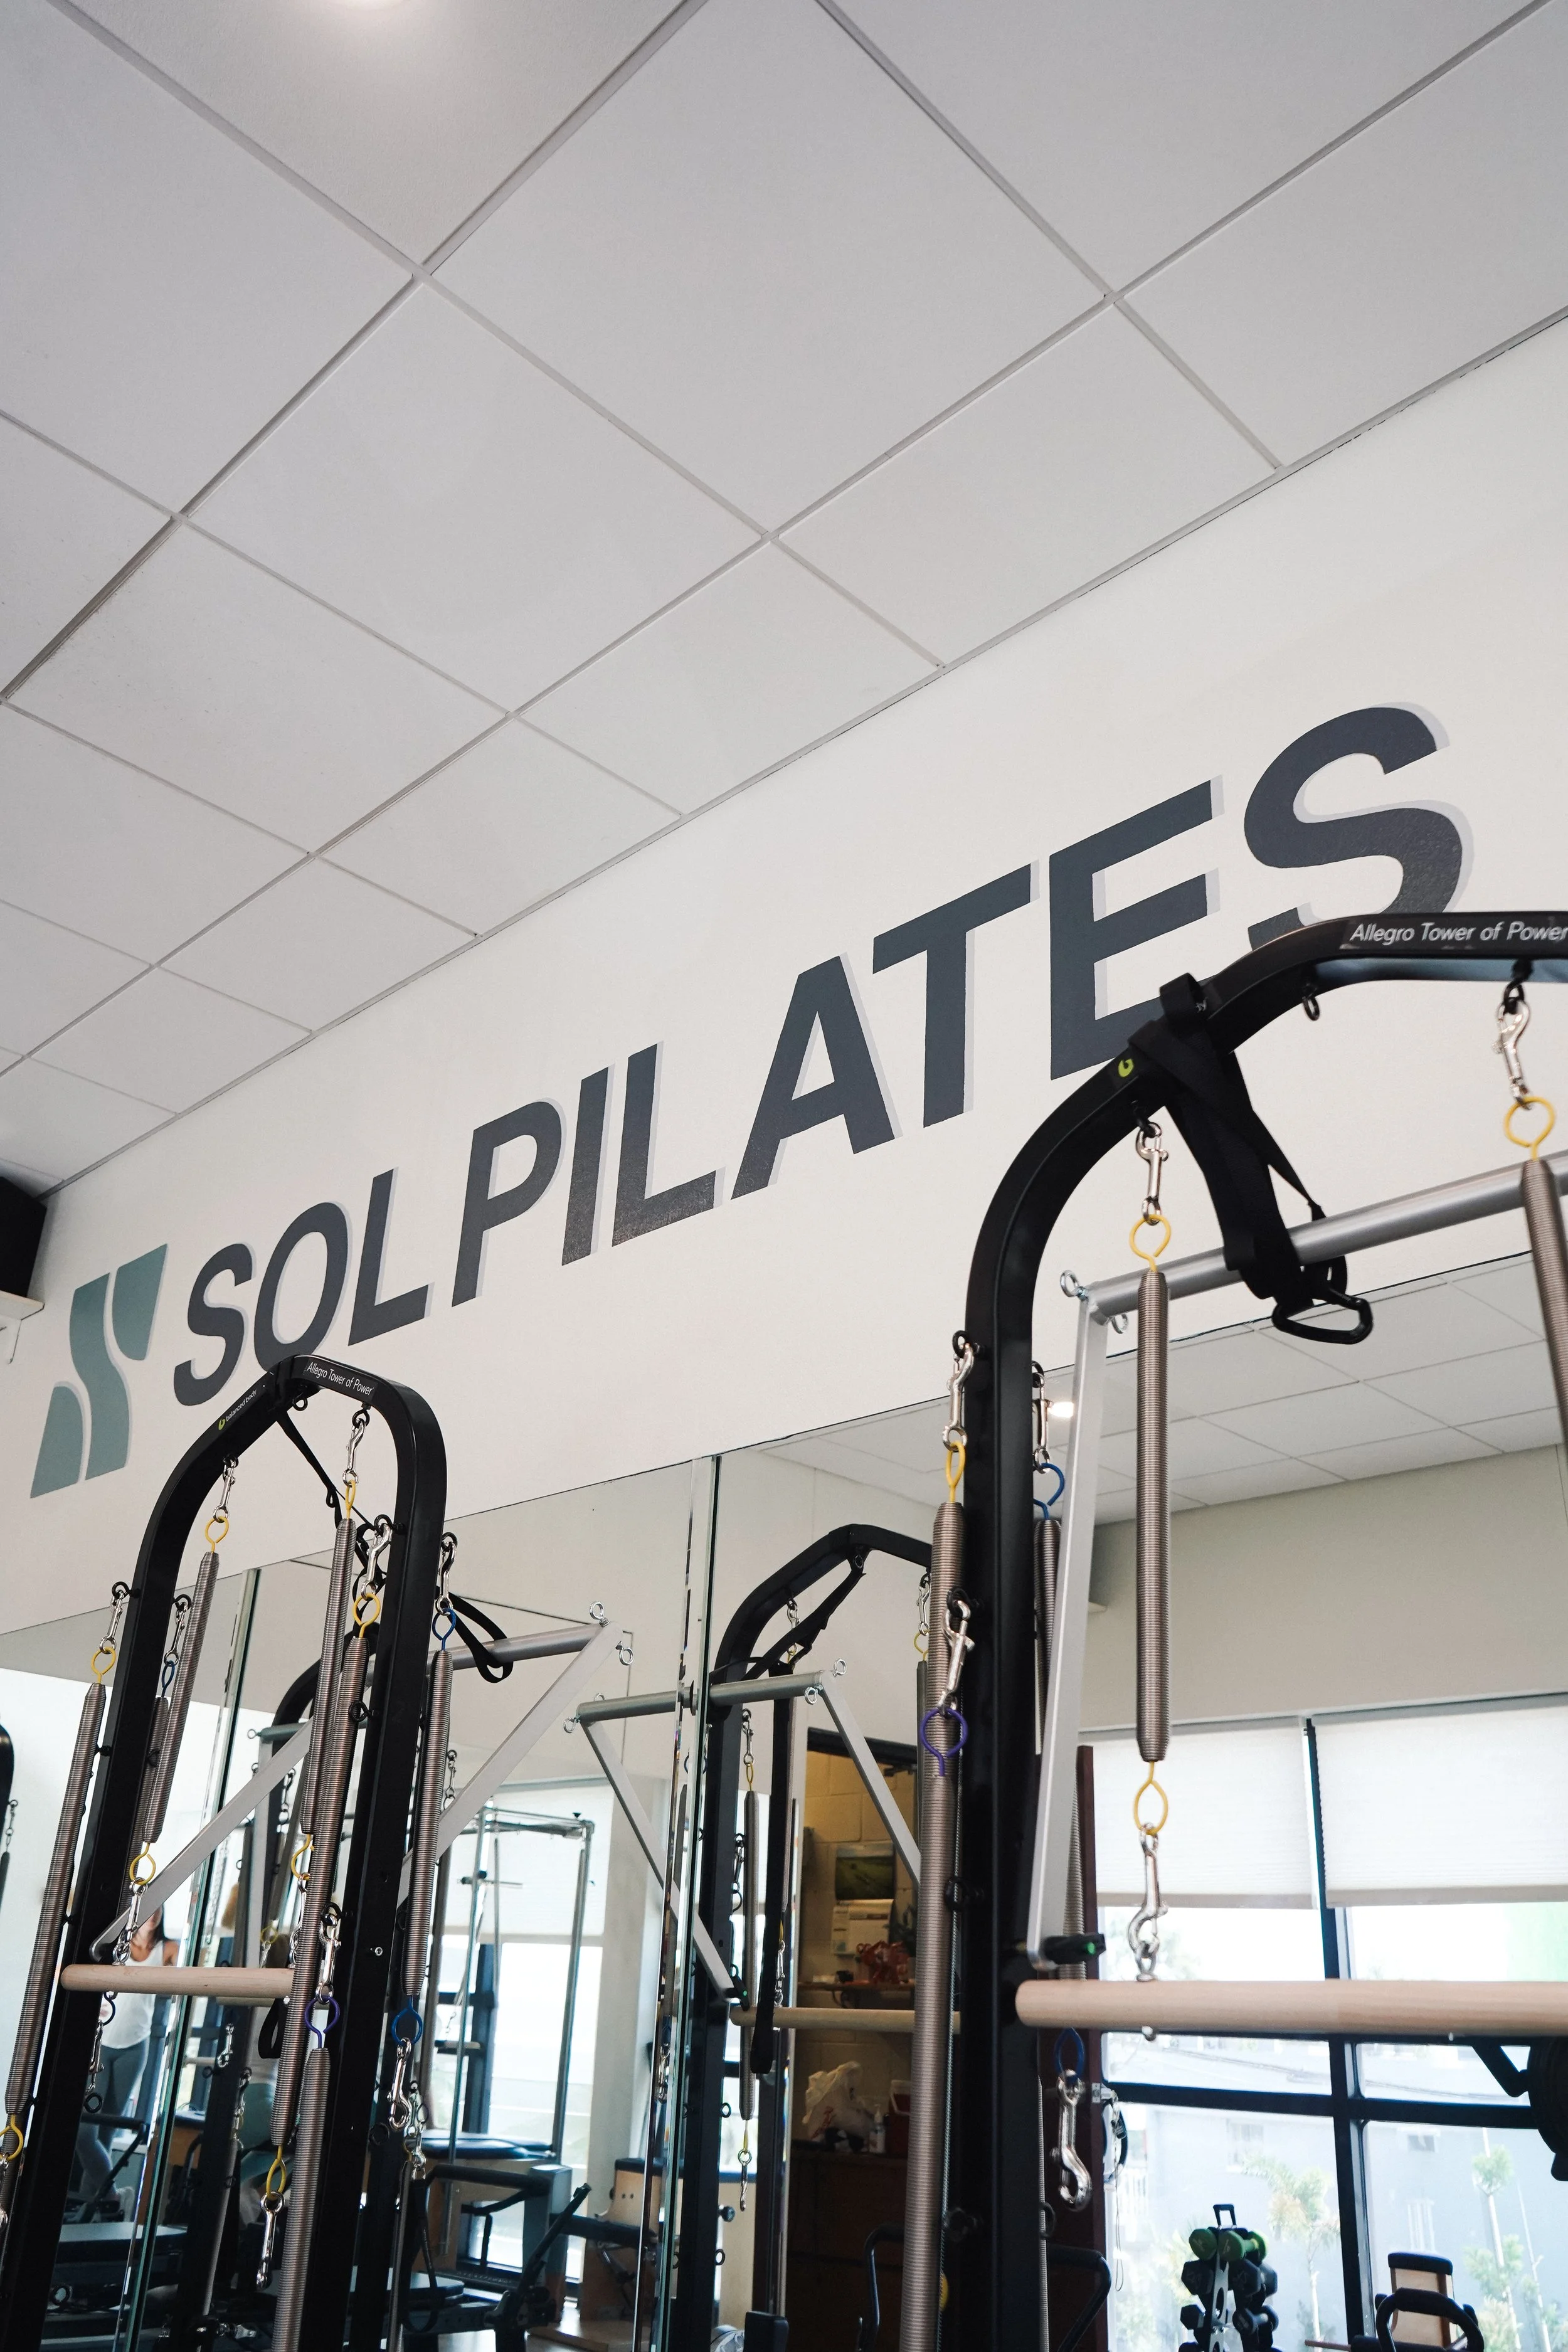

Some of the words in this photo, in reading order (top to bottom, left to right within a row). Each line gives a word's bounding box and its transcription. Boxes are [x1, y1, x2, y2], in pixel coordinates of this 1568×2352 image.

[1349, 922, 1415, 946] Allegro
[1420, 921, 1476, 941] Tower
[1480, 921, 1505, 941] of
[1506, 920, 1568, 941] Power
[174, 1168, 432, 1406] SOL
[452, 704, 1468, 1307] PILATES
[306, 1361, 328, 1379] Allegro
[328, 1368, 346, 1385] Tower
[345, 1377, 355, 1388] of
[352, 1379, 373, 1396] Power
[226, 1399, 245, 1422] balanced
[245, 1389, 257, 1404] body
